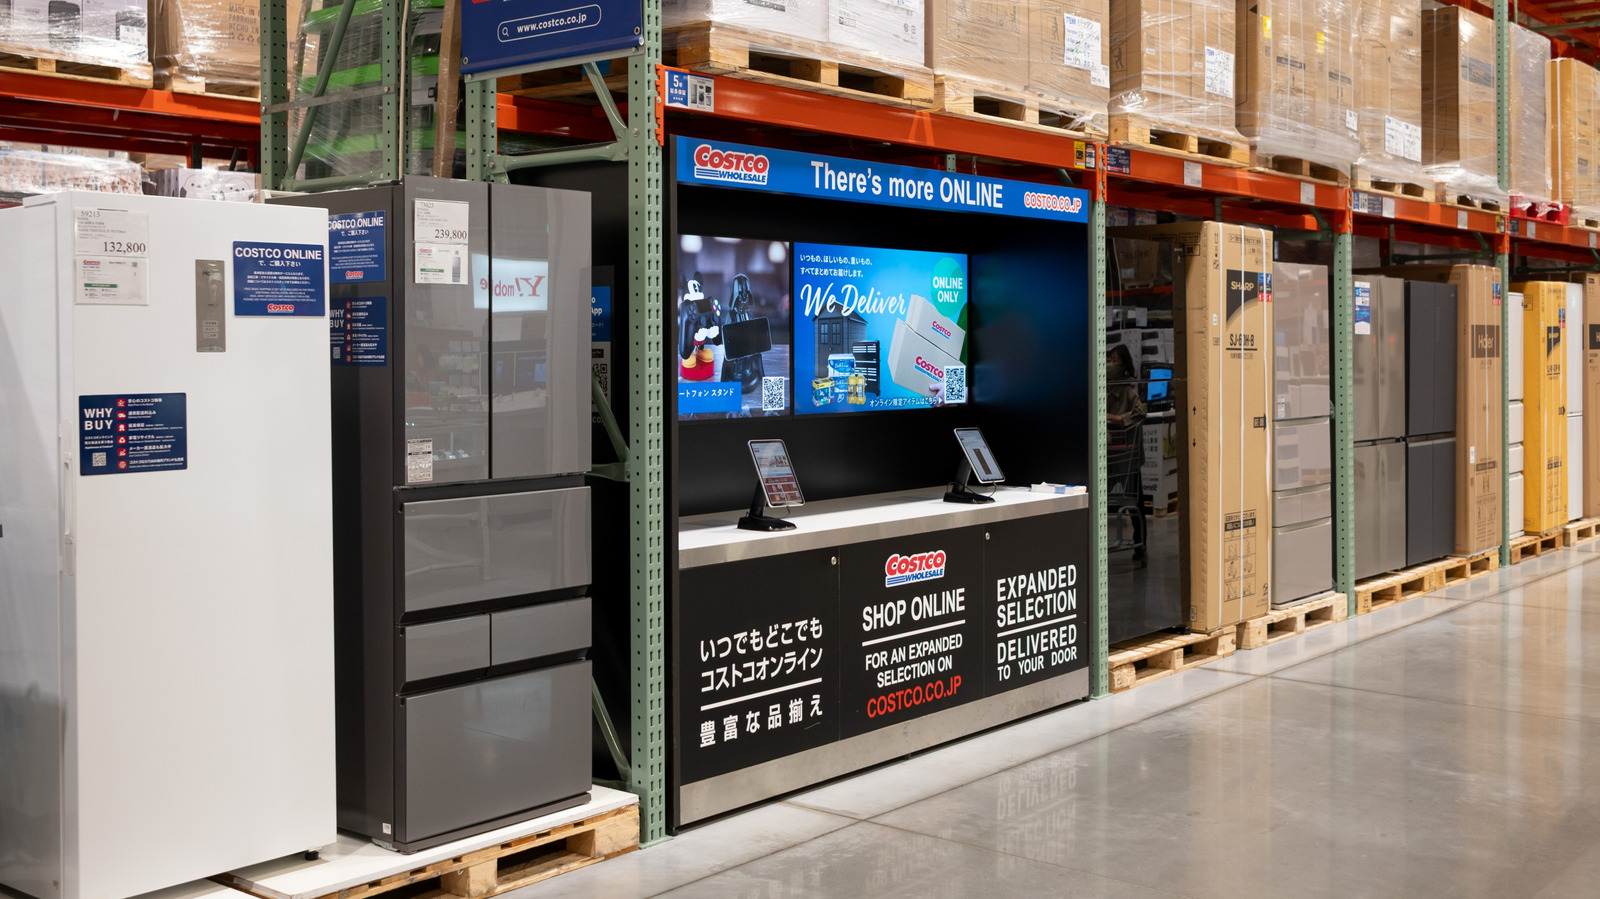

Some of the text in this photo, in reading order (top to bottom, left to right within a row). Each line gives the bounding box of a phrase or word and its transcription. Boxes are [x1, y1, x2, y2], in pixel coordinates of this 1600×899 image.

[229, 4, 245, 14] MADE
[517, 12, 587, 33] www.costco.co.jp
[696, 146, 768, 173] COSTCO
[718, 171, 766, 182] WHOLESALE
[889, 178, 934, 201] more
[940, 177, 1003, 208] ONLINE
[1024, 192, 1082, 214] COSTCO.CO.JP
[357, 217, 383, 228] ONLINE
[435, 229, 467, 240] 239,800
[104, 242, 146, 254] 132,800
[235, 247, 322, 260] COSTCO ONLINE
[933, 277, 963, 289] ONLINE
[800, 283, 906, 316] We Deliver
[938, 291, 959, 302] ONLY
[933, 321, 951, 337] COSTCO
[916, 356, 944, 378] COSTCO
[712, 388, 734, 396] スタンド
[84, 408, 113, 418] WHY
[84, 420, 112, 430] BUY
[886, 551, 945, 576] COSTCO
[904, 569, 944, 582] WHOLESALE
[997, 564, 1077, 602] EXPANDED
[862, 588, 965, 631] SHOP ONLINE
[997, 589, 1077, 628] SELECTION
[700, 616, 823, 662] いつでもどこでも
[997, 624, 1077, 664] DELIVERED
[866, 633, 963, 670] FOR AN EXPANDED
[701, 648, 823, 693] コストコオンライン
[877, 655, 952, 688] SELECTION ON
[998, 646, 1077, 681] TO YOUR DOOR
[867, 675, 962, 718] COSTCO.CO.JP
[700, 694, 823, 748] 豊富な品揃え
